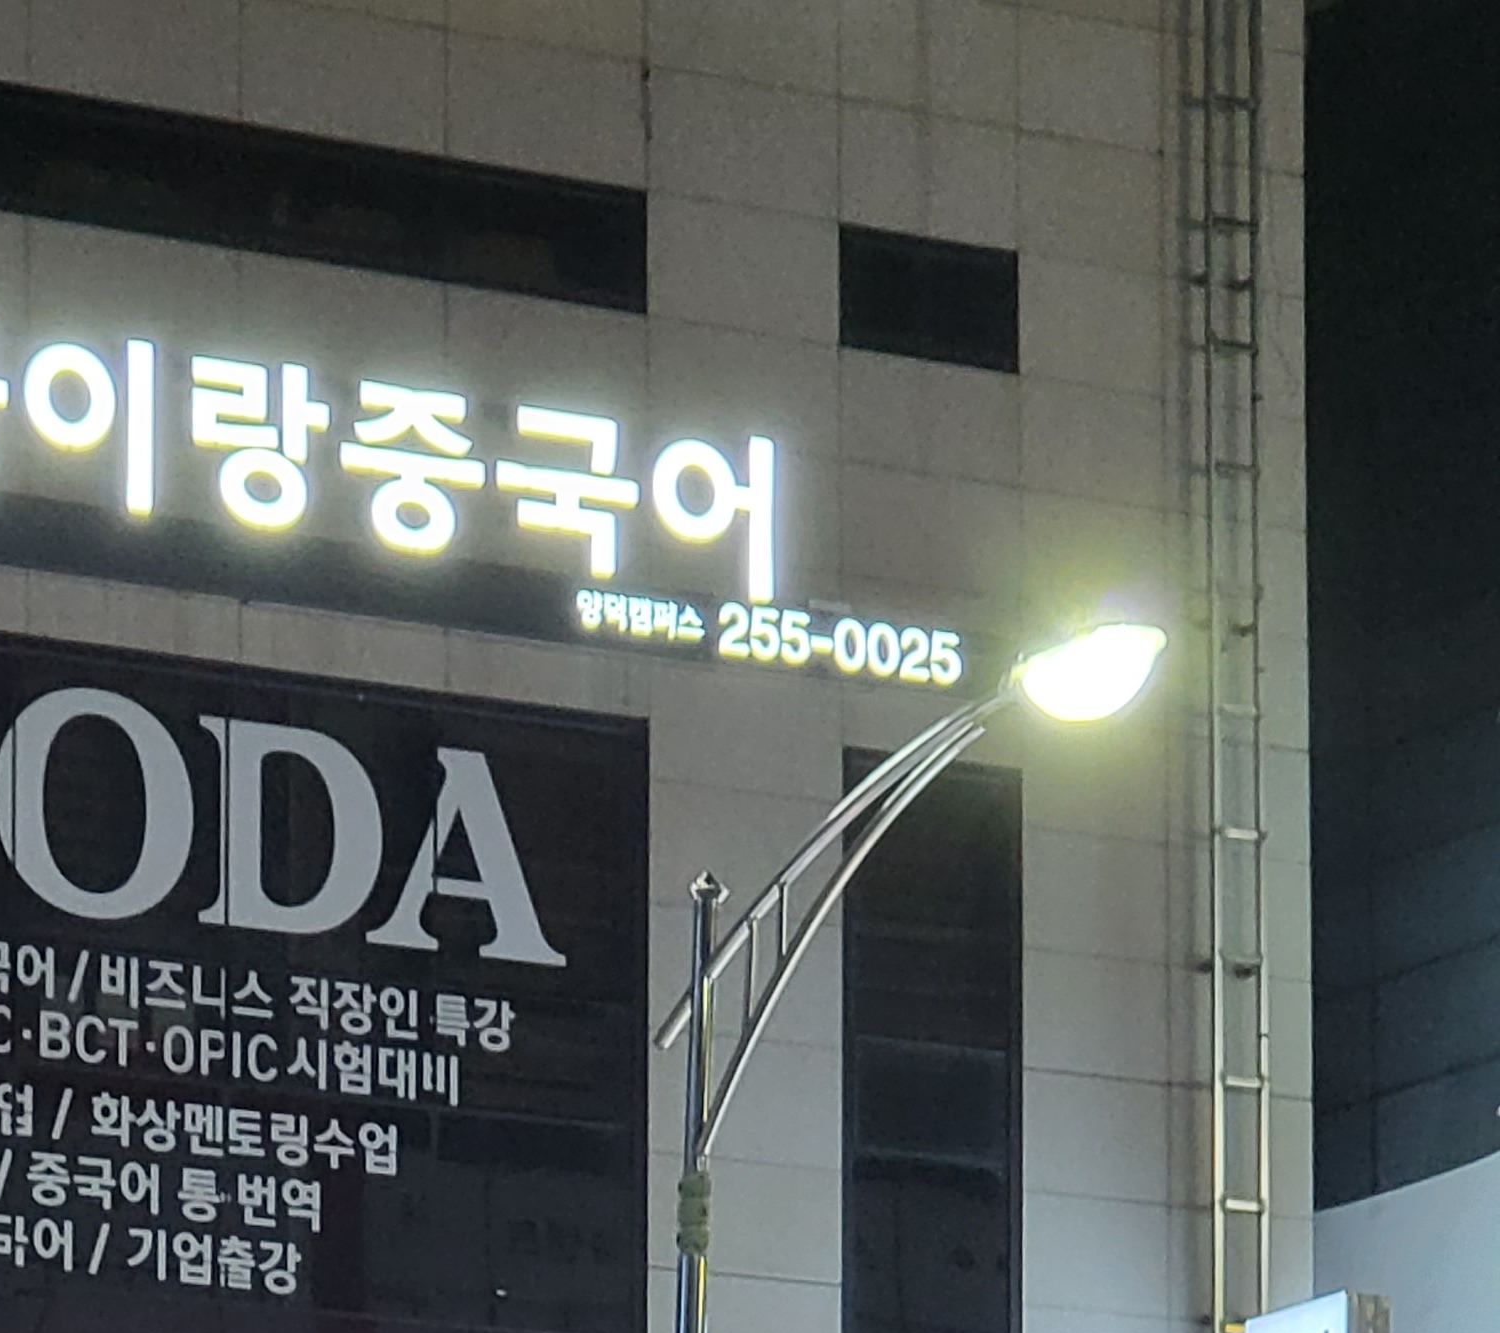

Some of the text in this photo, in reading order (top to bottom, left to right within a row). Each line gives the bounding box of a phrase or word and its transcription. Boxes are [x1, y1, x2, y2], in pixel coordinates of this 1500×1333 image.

[718, 600, 963, 687] 255-0025
[289, 974, 419, 1042] 직장인
[434, 993, 515, 1053] 특강
[91, 1091, 398, 1177] 화상멘토링수업
[26, 1151, 160, 1216] 중국어
[126, 1227, 302, 1297] 기업출강
